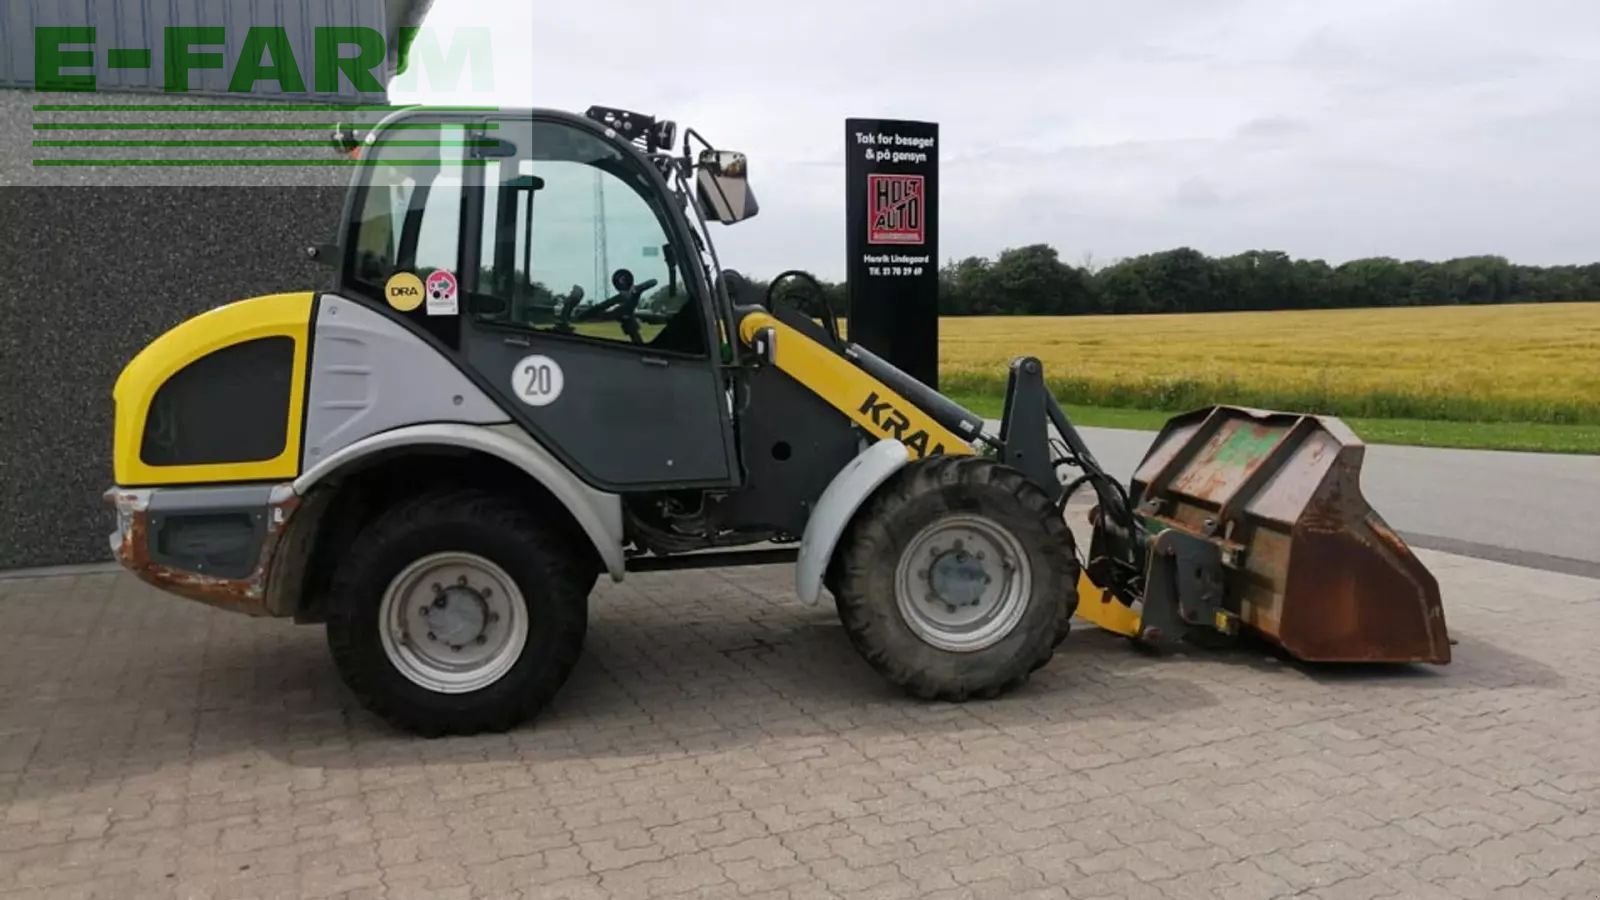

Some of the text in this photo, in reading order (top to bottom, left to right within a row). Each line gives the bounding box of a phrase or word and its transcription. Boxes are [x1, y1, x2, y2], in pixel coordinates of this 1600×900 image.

[856, 132, 875, 144] Tak
[877, 133, 893, 145] for
[865, 148, 875, 160] &
[876, 149, 891, 162] på
[877, 180, 917, 212] HOLT
[876, 198, 918, 229] AUTO
[391, 287, 418, 297] DRA
[524, 364, 551, 396] 20
